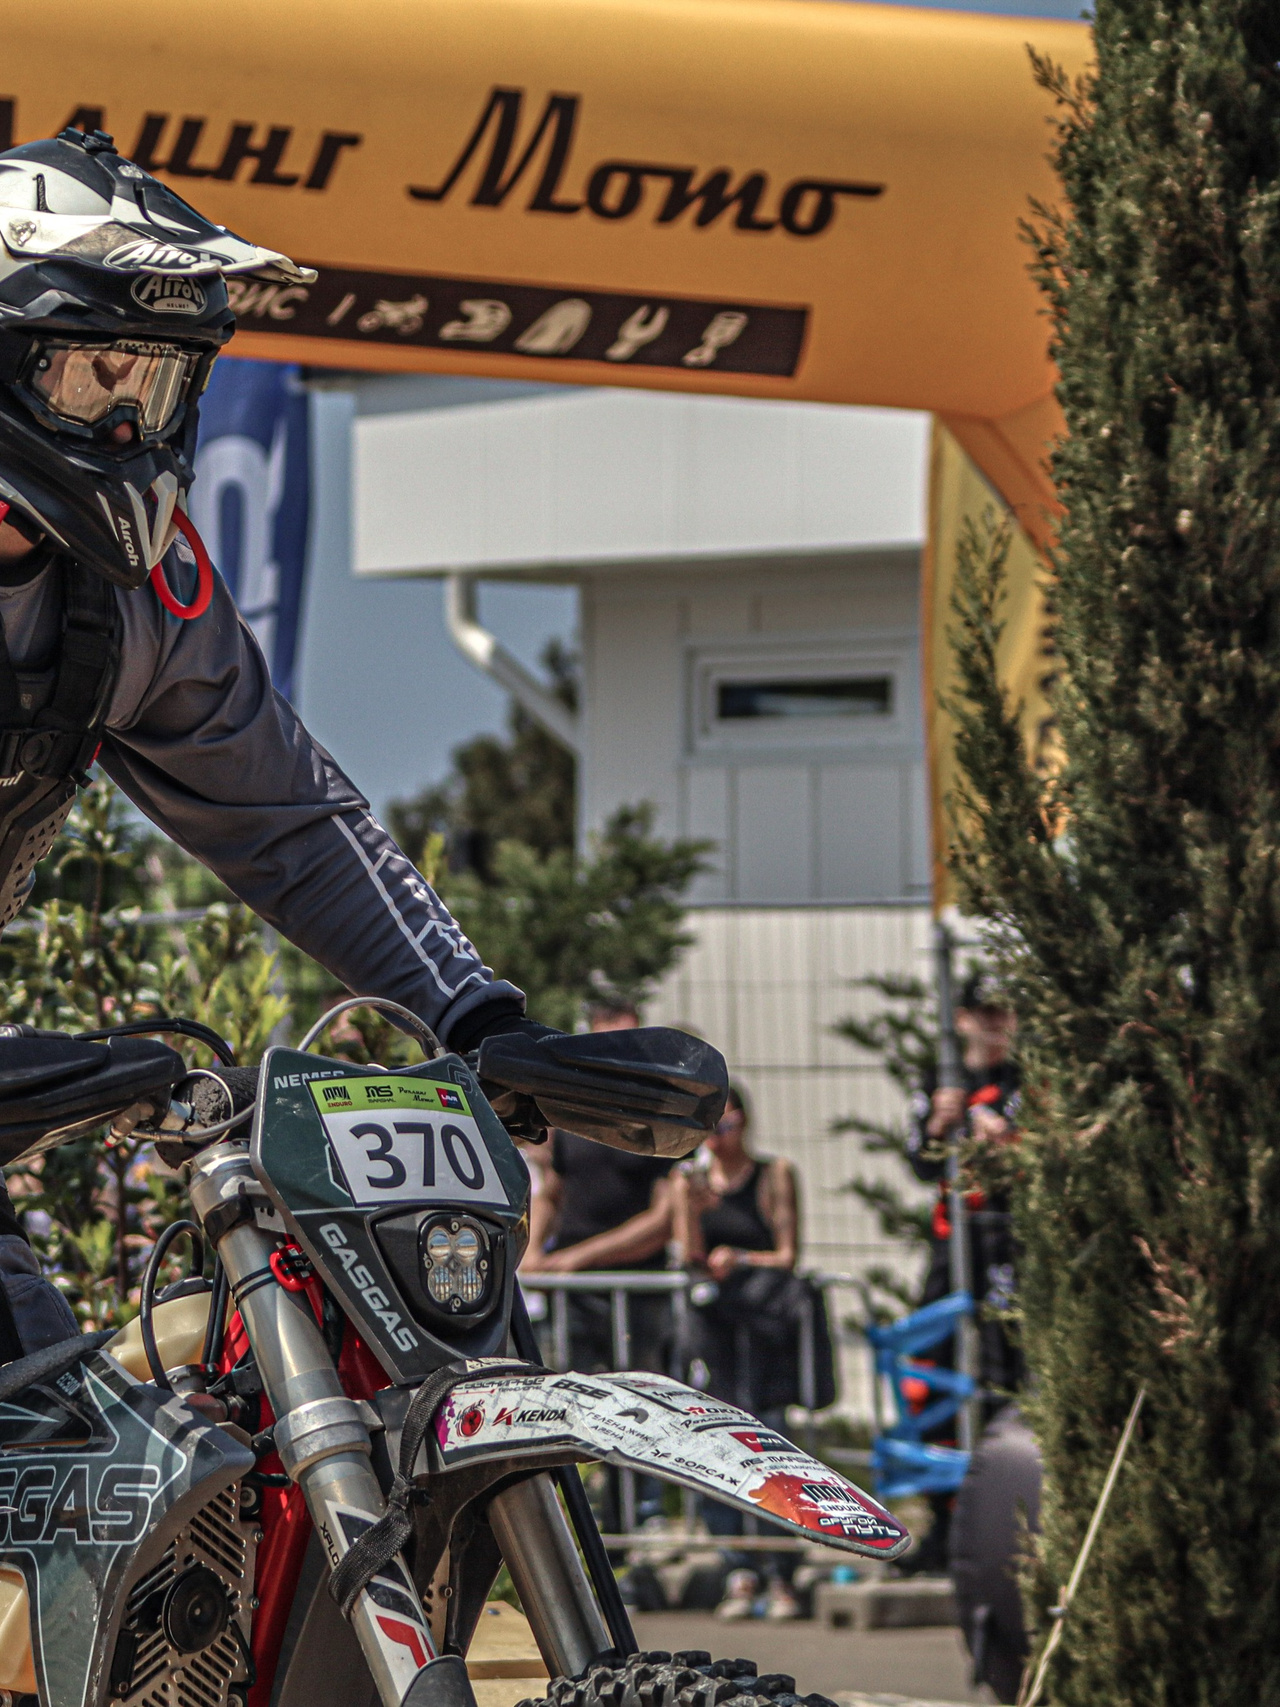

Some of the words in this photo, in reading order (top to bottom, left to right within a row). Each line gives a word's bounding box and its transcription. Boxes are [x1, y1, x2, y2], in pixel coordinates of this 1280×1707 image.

[139, 276, 206, 304] Airoh
[118, 516, 139, 567] Airoh
[327, 1100, 354, 1108] ENDURO
[349, 1121, 486, 1190] 370
[319, 1222, 418, 1352] GASGAS
[515, 1408, 568, 1423] KENDA
[586, 1411, 651, 1443] ГЕЛЕНДЖИК
[590, 1424, 625, 1441] АРЕНА
[673, 1456, 742, 1487] ФОРСАЖ
[819, 1517, 878, 1527] ДРУГОЙ
[820, 1504, 868, 1513] ENDURO
[320, 1521, 340, 1566] XPLO
[842, 1524, 902, 1537] ПУТЬ
